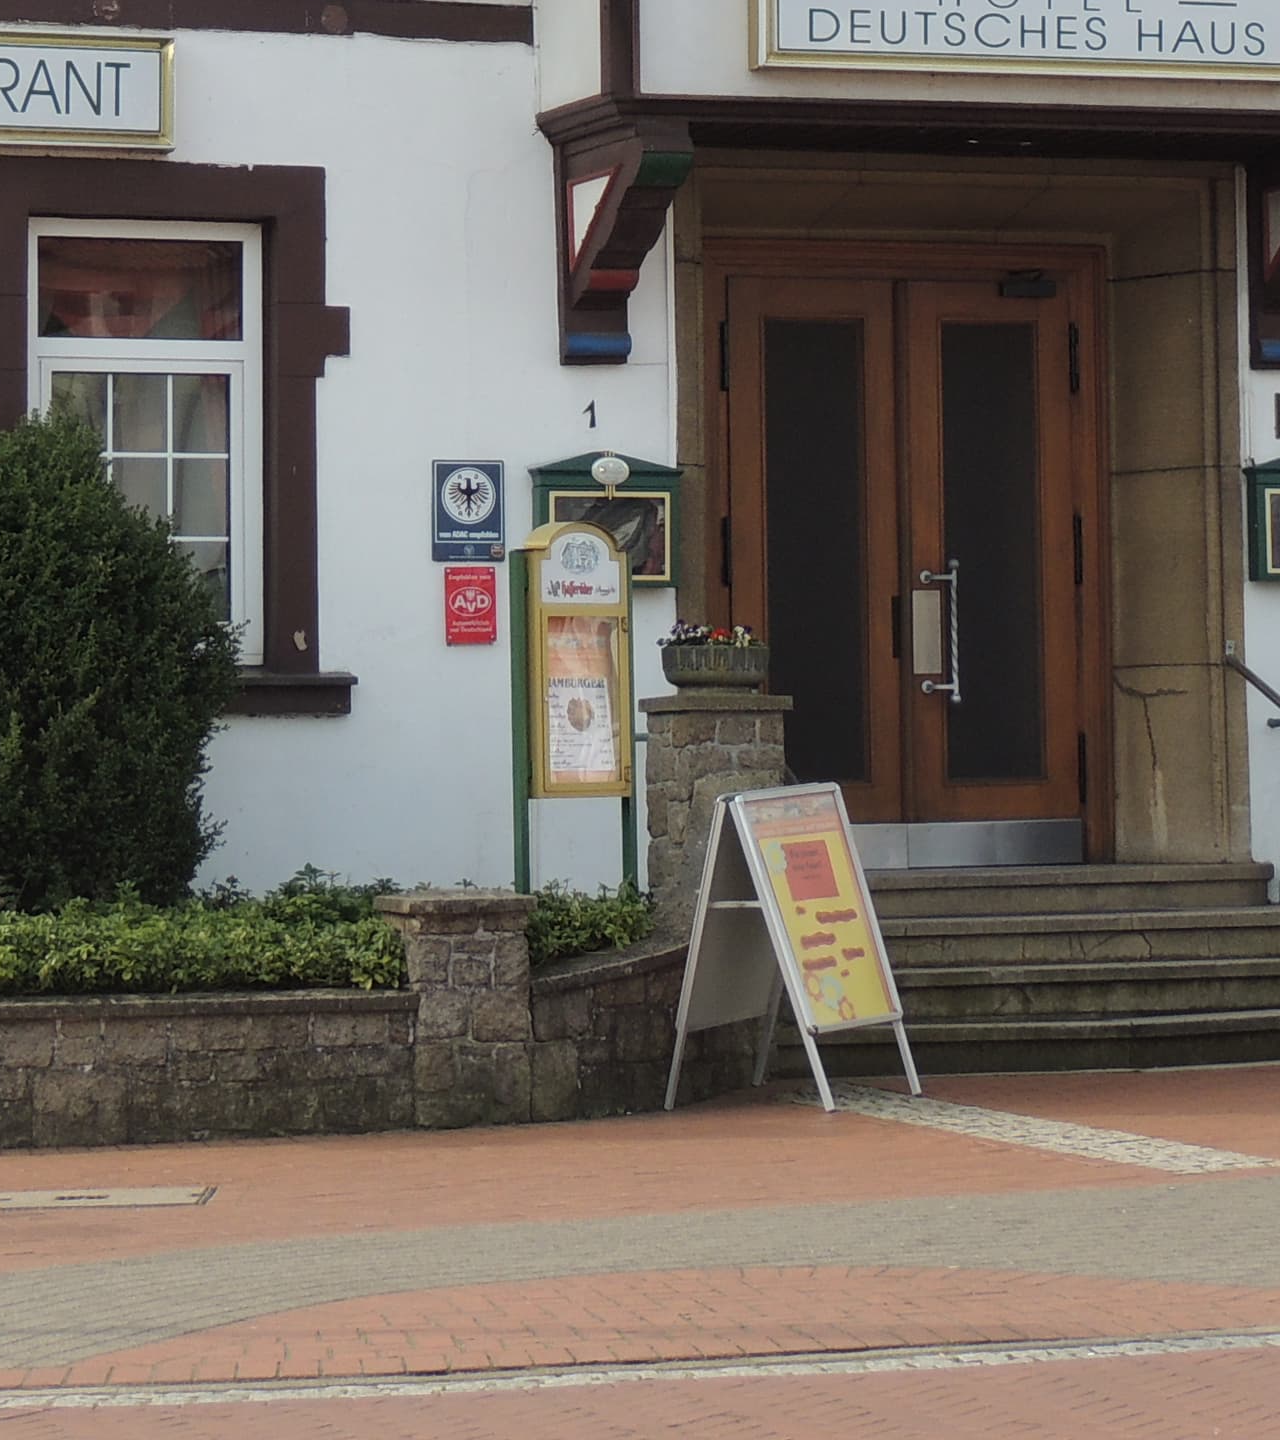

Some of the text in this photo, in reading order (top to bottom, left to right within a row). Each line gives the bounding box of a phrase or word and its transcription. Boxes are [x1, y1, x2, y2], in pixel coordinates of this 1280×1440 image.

[808, 7, 1266, 57] DEUTSCHES HAUS
[582, 399, 596, 428] 1
